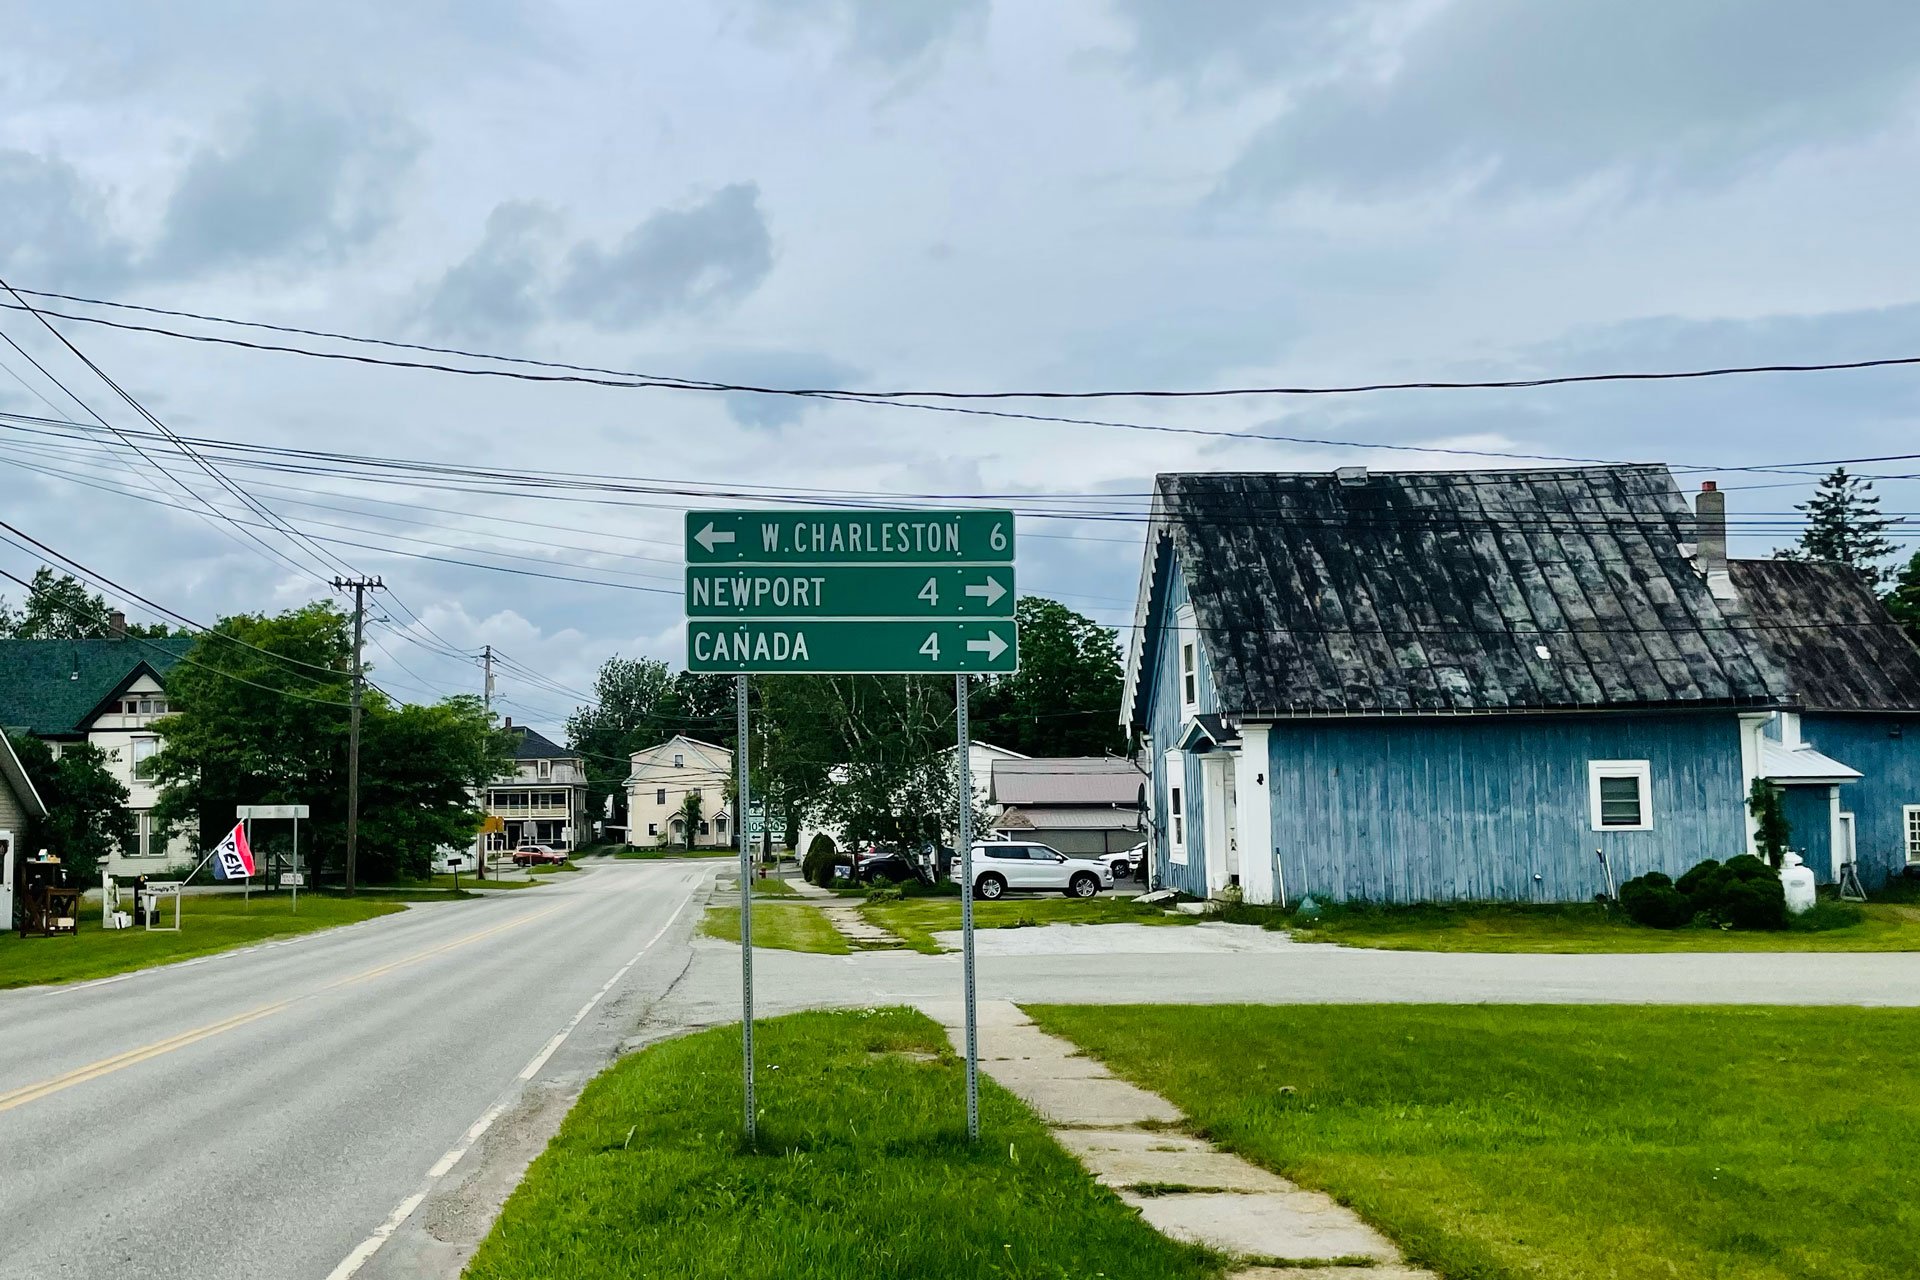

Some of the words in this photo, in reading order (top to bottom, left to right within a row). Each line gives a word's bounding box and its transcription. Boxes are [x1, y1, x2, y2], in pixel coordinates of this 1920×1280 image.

[990, 523, 1007, 551] 6
[693, 577, 826, 607] NEWPORT
[917, 577, 939, 606] 4
[694, 632, 810, 662] CANADA
[918, 632, 941, 661] 4
